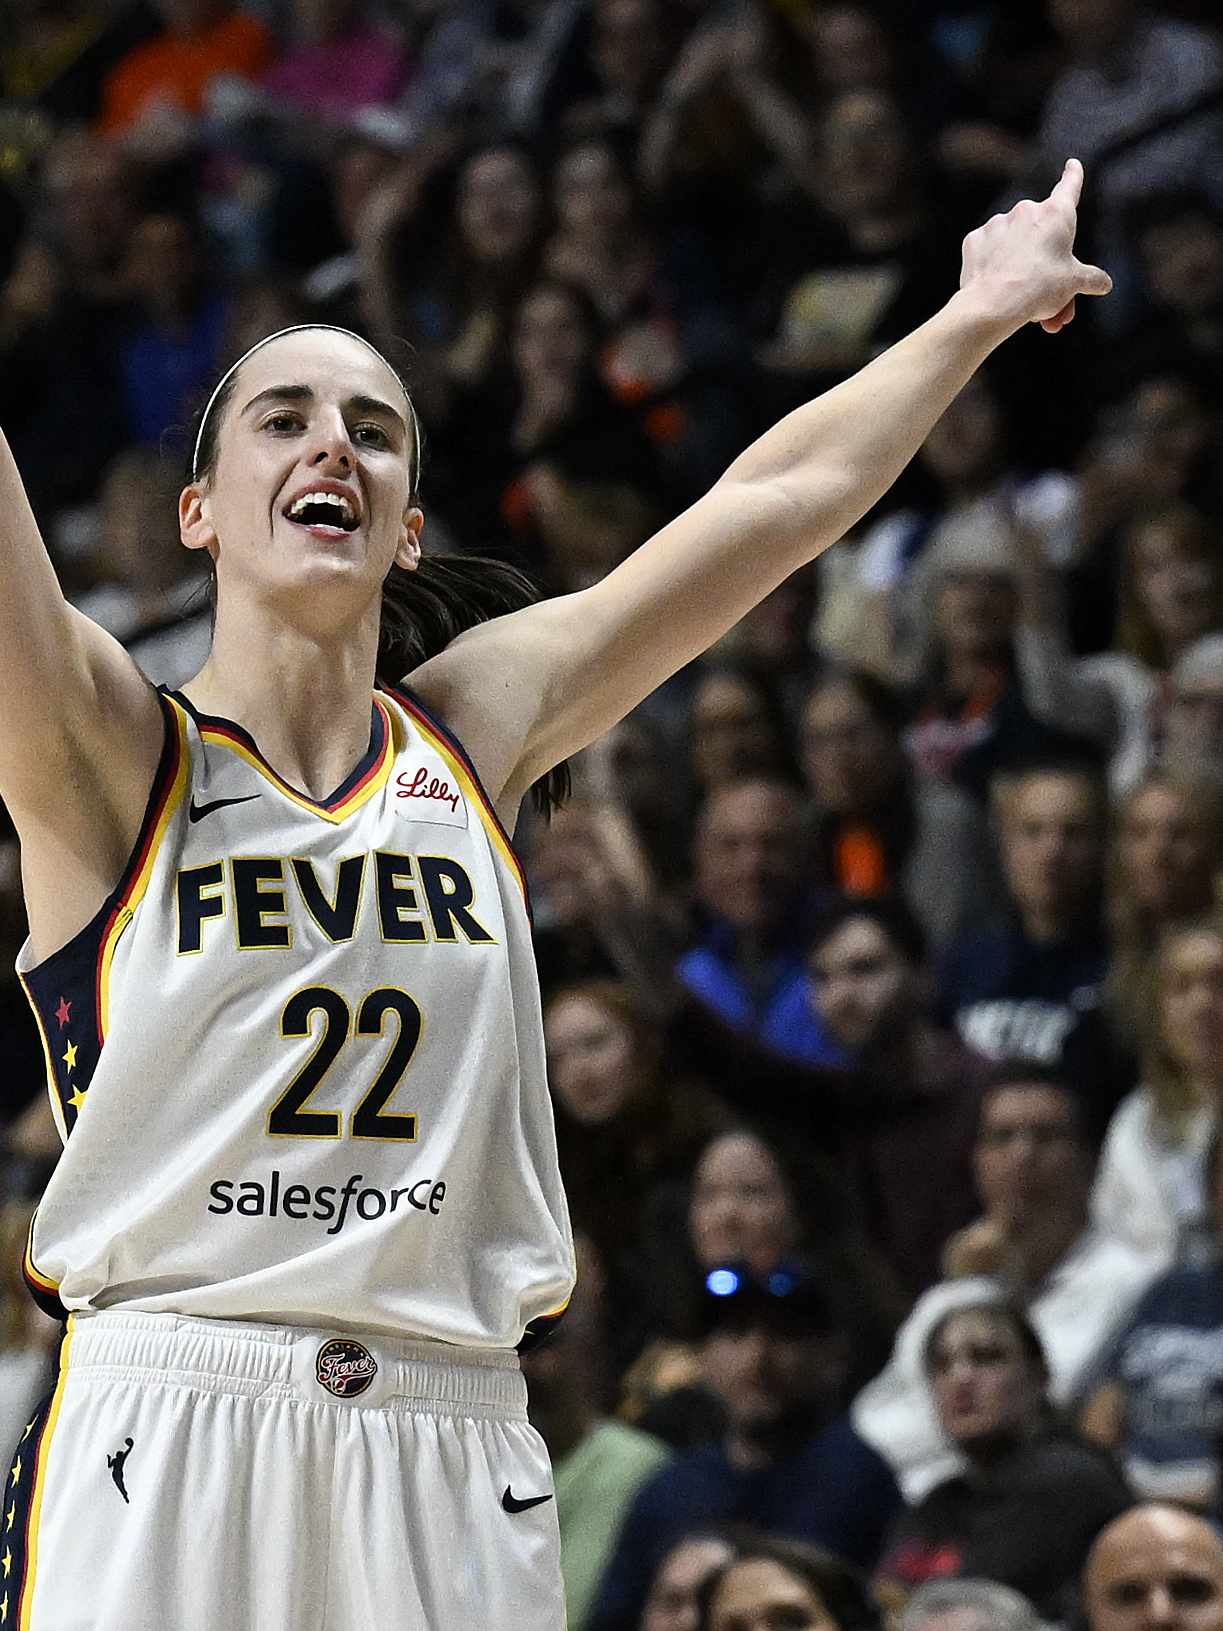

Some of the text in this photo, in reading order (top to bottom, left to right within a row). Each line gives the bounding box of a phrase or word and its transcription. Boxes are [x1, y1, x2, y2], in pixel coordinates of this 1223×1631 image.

[396, 767, 460, 812] Lilly
[176, 850, 499, 956] FEVER
[266, 984, 424, 1142] 22
[207, 1170, 447, 1235] salesforce
[318, 1353, 376, 1383] Fever
